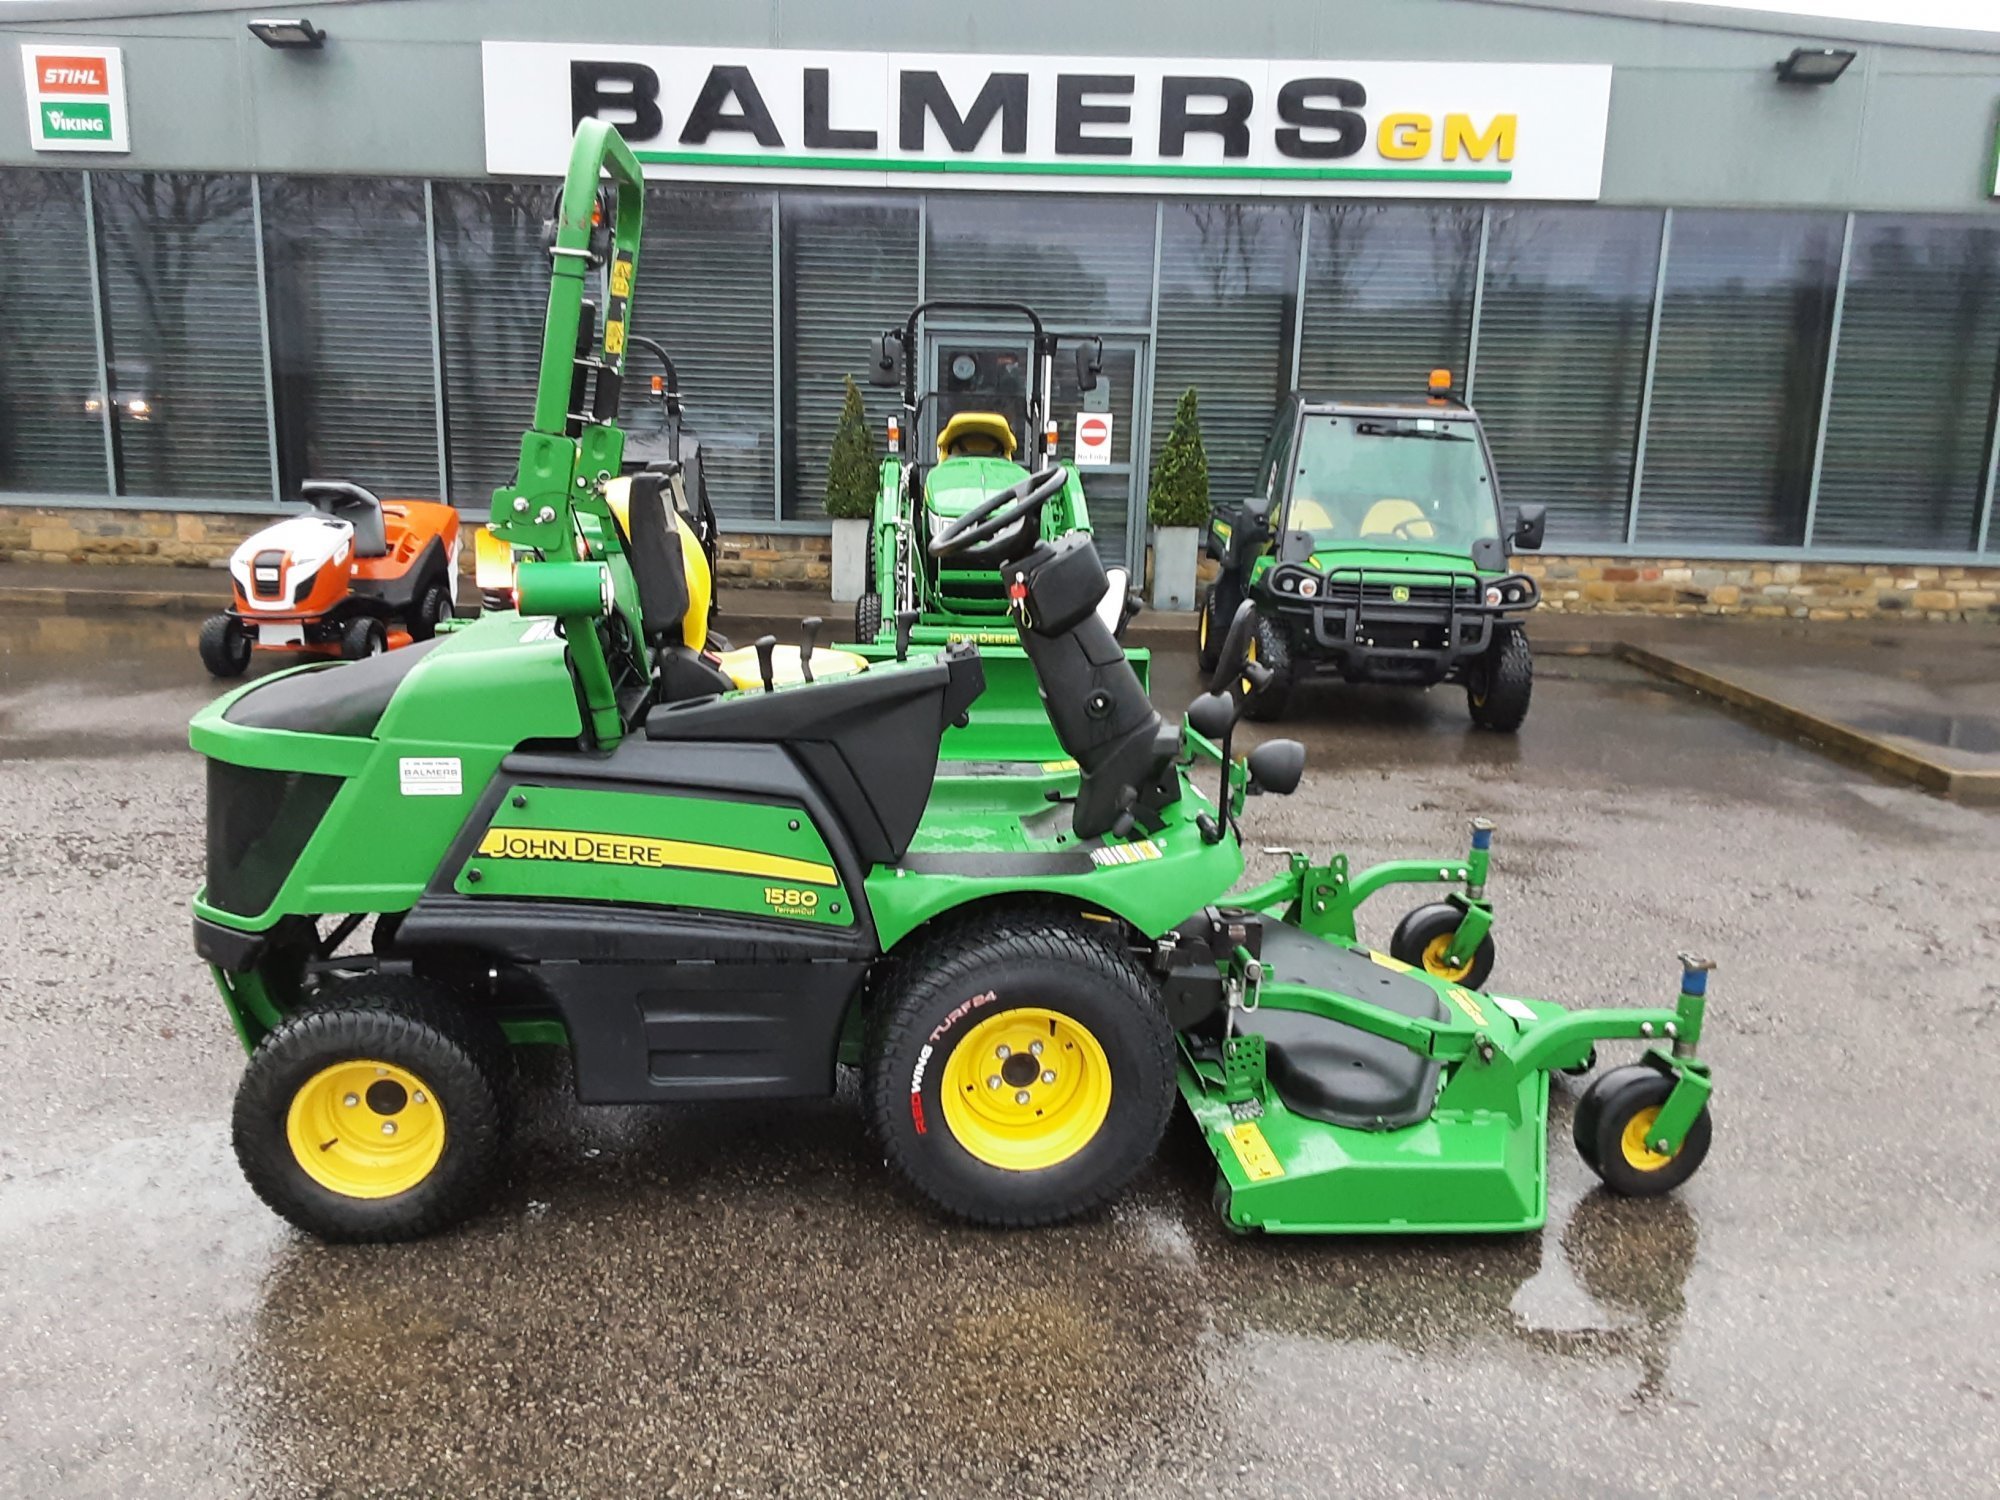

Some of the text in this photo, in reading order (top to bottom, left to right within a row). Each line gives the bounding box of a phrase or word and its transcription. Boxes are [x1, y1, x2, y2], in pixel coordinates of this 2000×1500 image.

[44, 68, 100, 85] STIHL
[46, 110, 104, 132] VIKING
[979, 633, 1017, 644] DEERE
[493, 834, 663, 864] JOHN DEERE
[764, 887, 818, 907] 1580
[774, 904, 816, 917] TerrainCut
